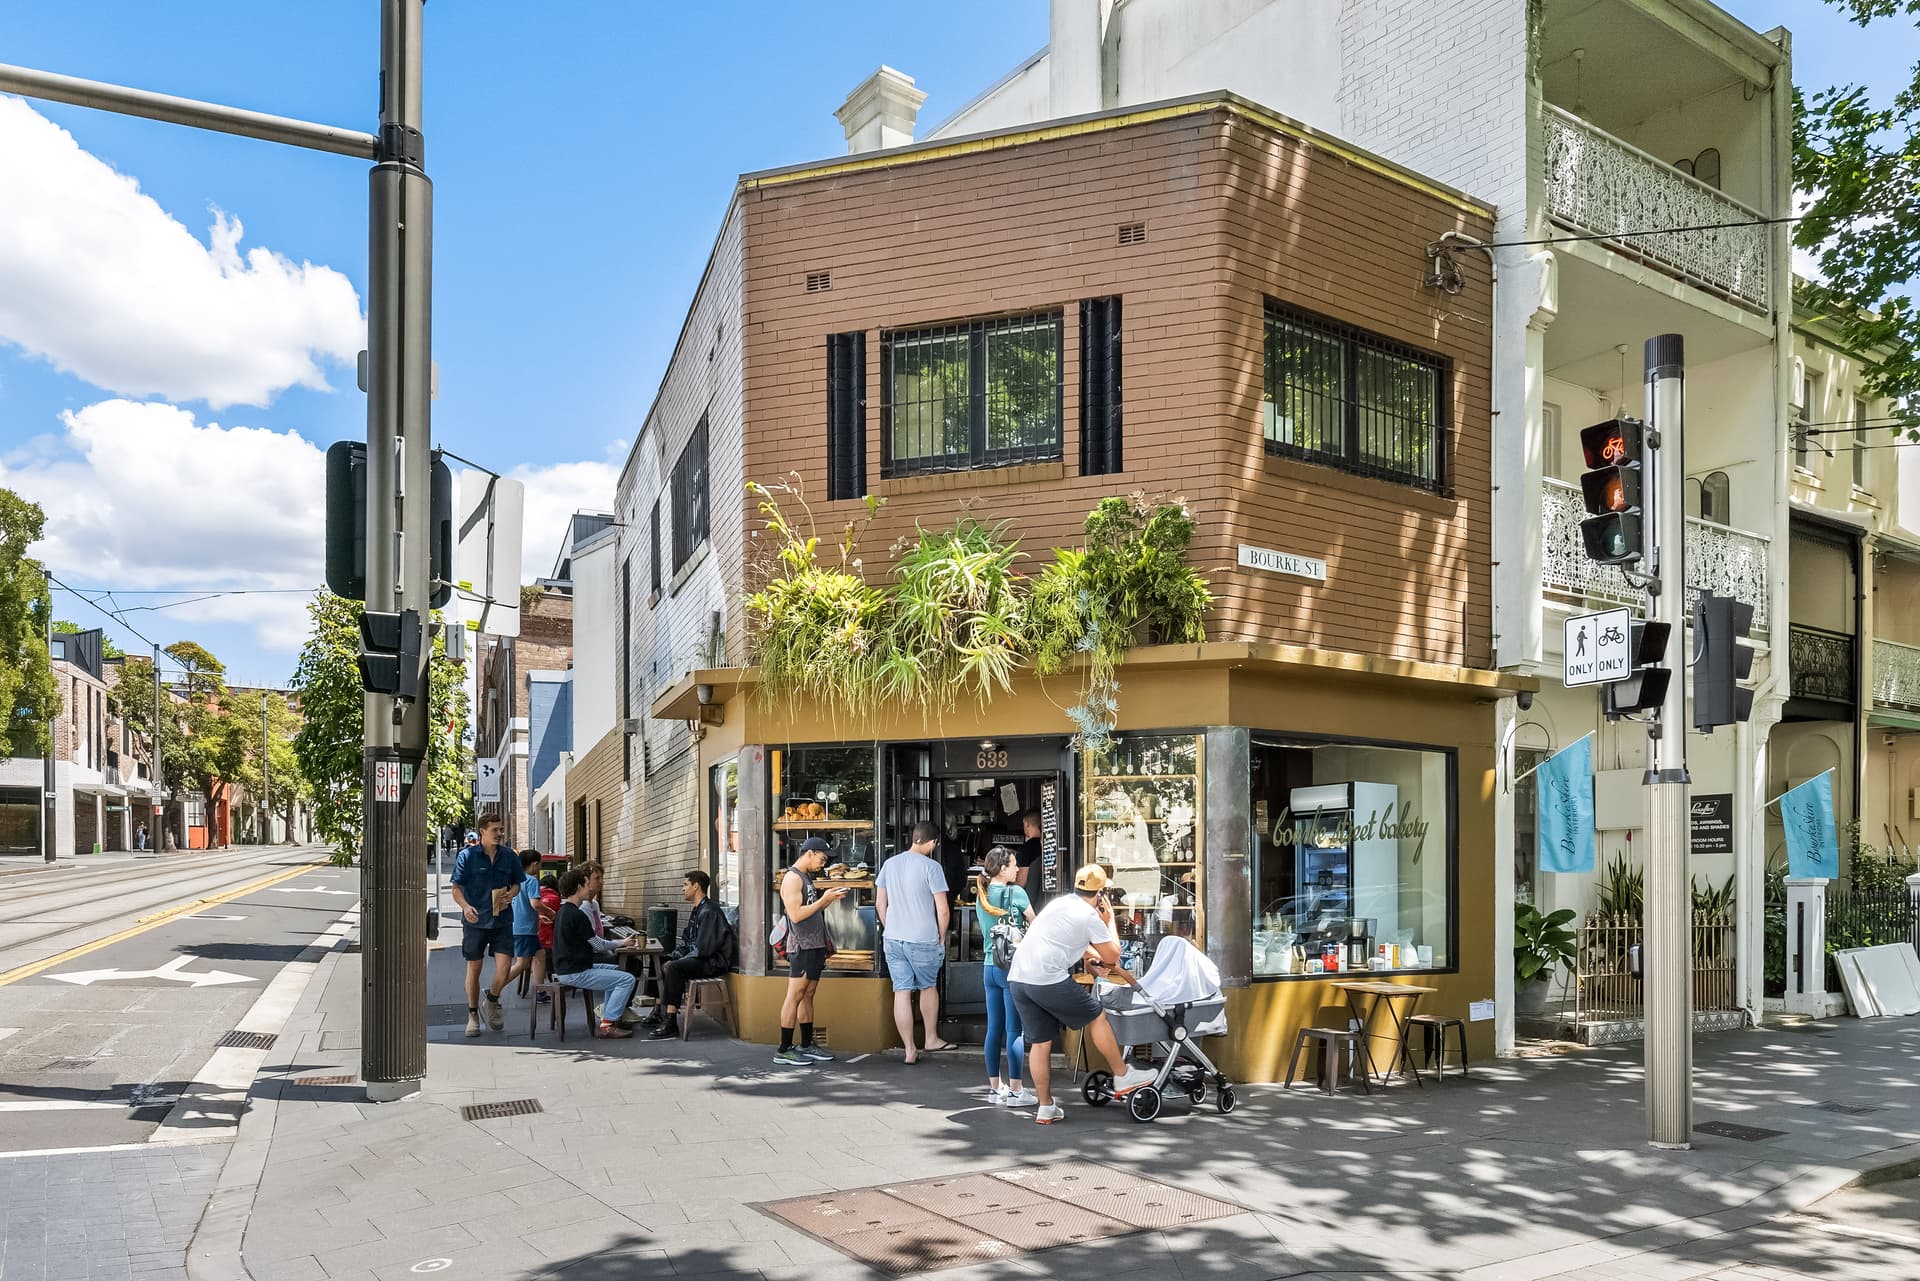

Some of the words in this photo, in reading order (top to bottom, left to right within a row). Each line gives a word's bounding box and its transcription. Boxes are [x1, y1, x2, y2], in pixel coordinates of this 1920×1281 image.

[1250, 550, 1300, 573] BOURKE
[1305, 561, 1320, 576] ST
[1569, 662, 1593, 676] ONLY
[1599, 657, 1624, 671] ONLY
[976, 751, 1008, 769] 633
[403, 767, 412, 780] H
[1272, 804, 1328, 847] bourke
[1330, 809, 1377, 845] street
[1379, 801, 1429, 865] bakery
